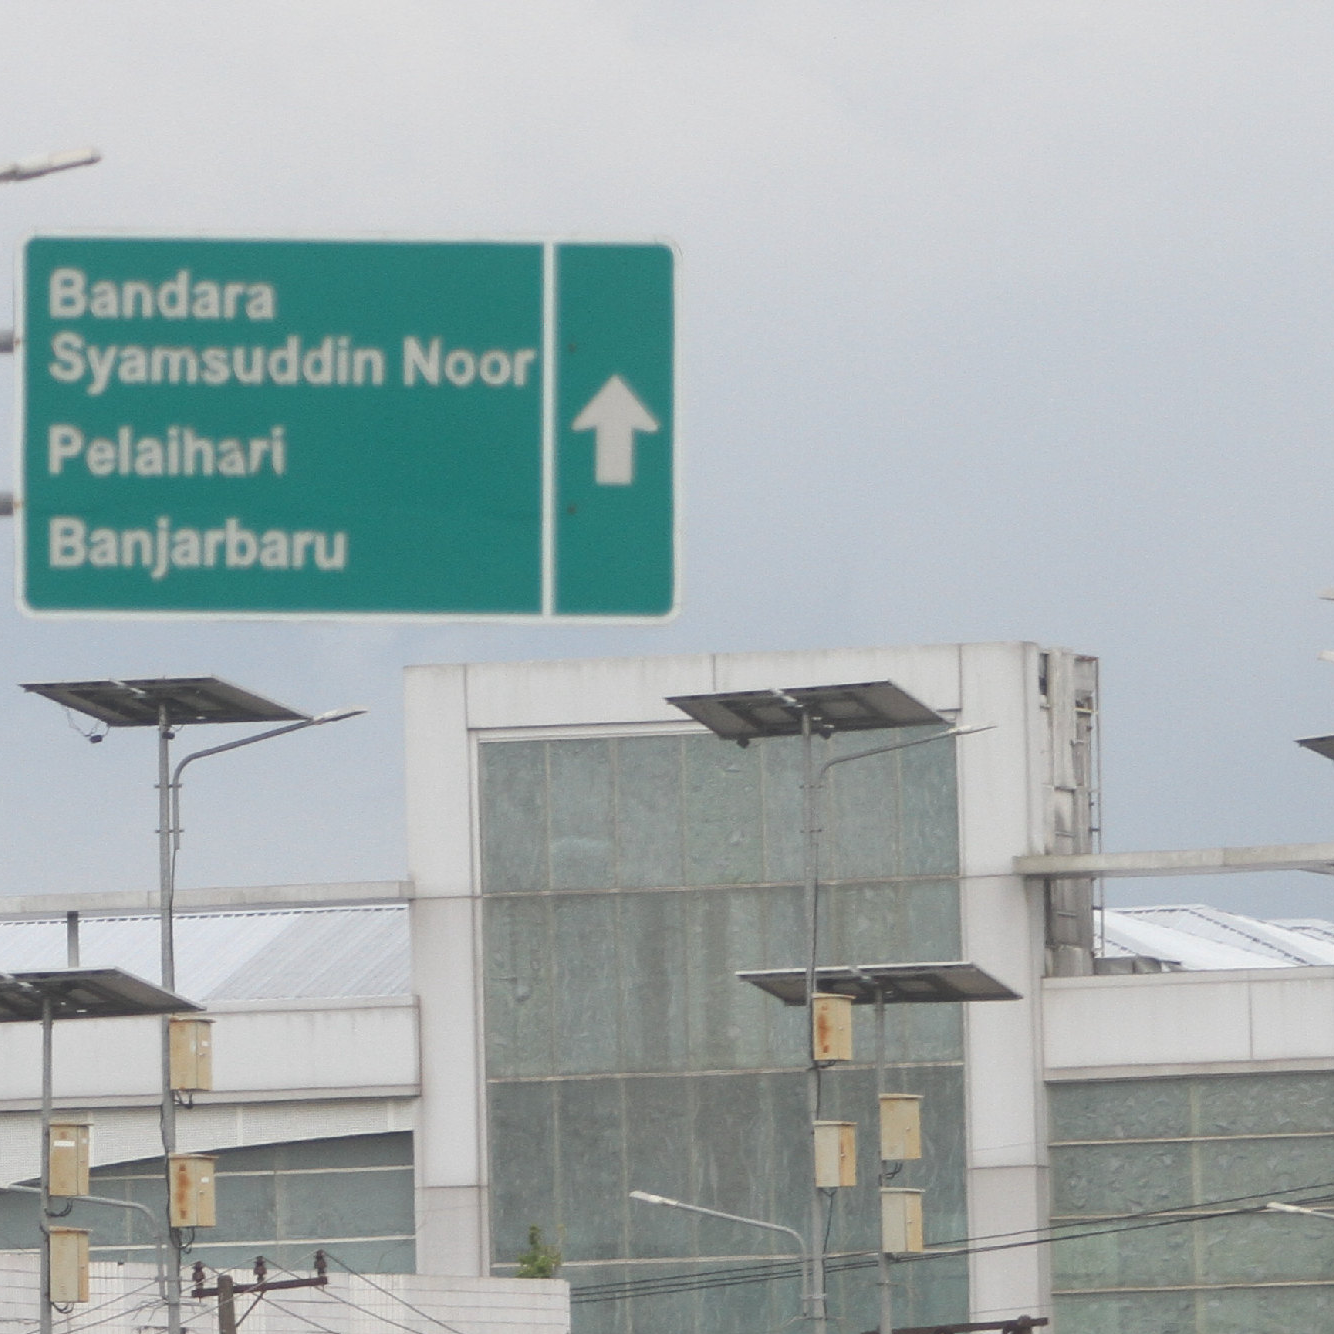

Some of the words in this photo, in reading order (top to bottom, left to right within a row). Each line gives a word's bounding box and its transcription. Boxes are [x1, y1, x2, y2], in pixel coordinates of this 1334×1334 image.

[48, 267, 276, 321] Bandara
[48, 331, 384, 395] Syamsuddin
[402, 336, 535, 387] Noor
[48, 424, 285, 477] Pelaihari
[48, 516, 347, 580] Banjarbaru
